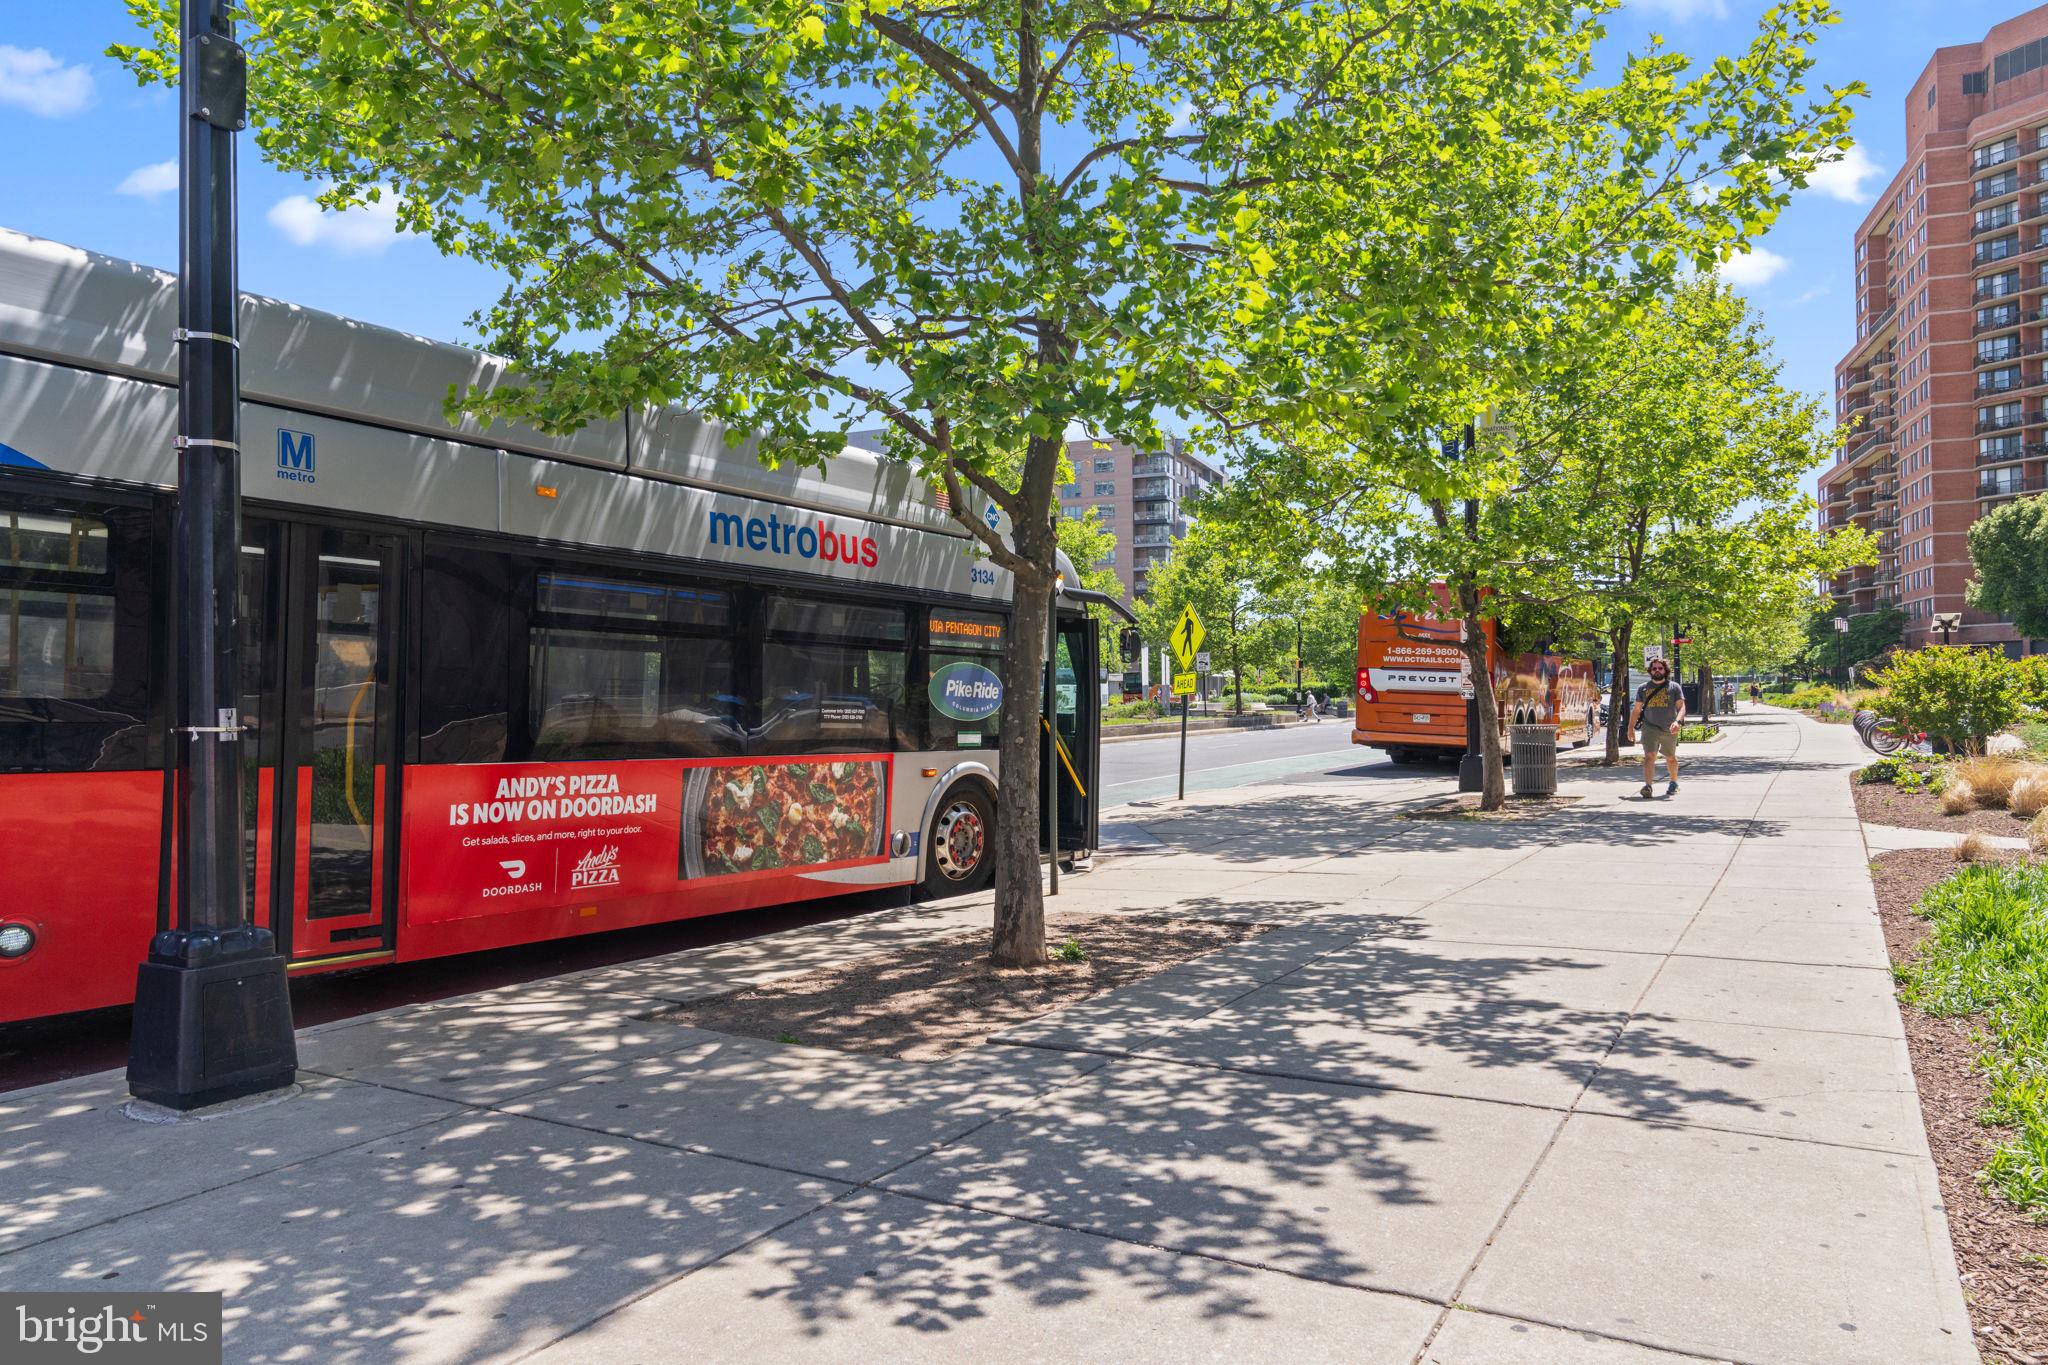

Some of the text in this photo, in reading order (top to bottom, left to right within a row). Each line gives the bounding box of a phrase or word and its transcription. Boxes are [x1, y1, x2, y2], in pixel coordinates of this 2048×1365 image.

[281, 431, 312, 470] M
[277, 470, 316, 484] metro
[709, 511, 878, 568] metrobus
[970, 568, 995, 585] 3134
[929, 619, 1001, 638] VIA PENTAGON CITY
[1387, 646, 1458, 656] 1-866-269-9800
[1176, 678, 1193, 689] AHEAD
[1388, 674, 1457, 683] PREVOST
[496, 774, 620, 798] ANDY'S PIZZA
[450, 794, 657, 826] IS NOW ON DOORDASH
[462, 825, 642, 847] Get salads, slices, and more, right to your door.
[574, 845, 619, 871] Andy's
[571, 868, 620, 886] PIZZA
[482, 882, 542, 897] DOORDASH
